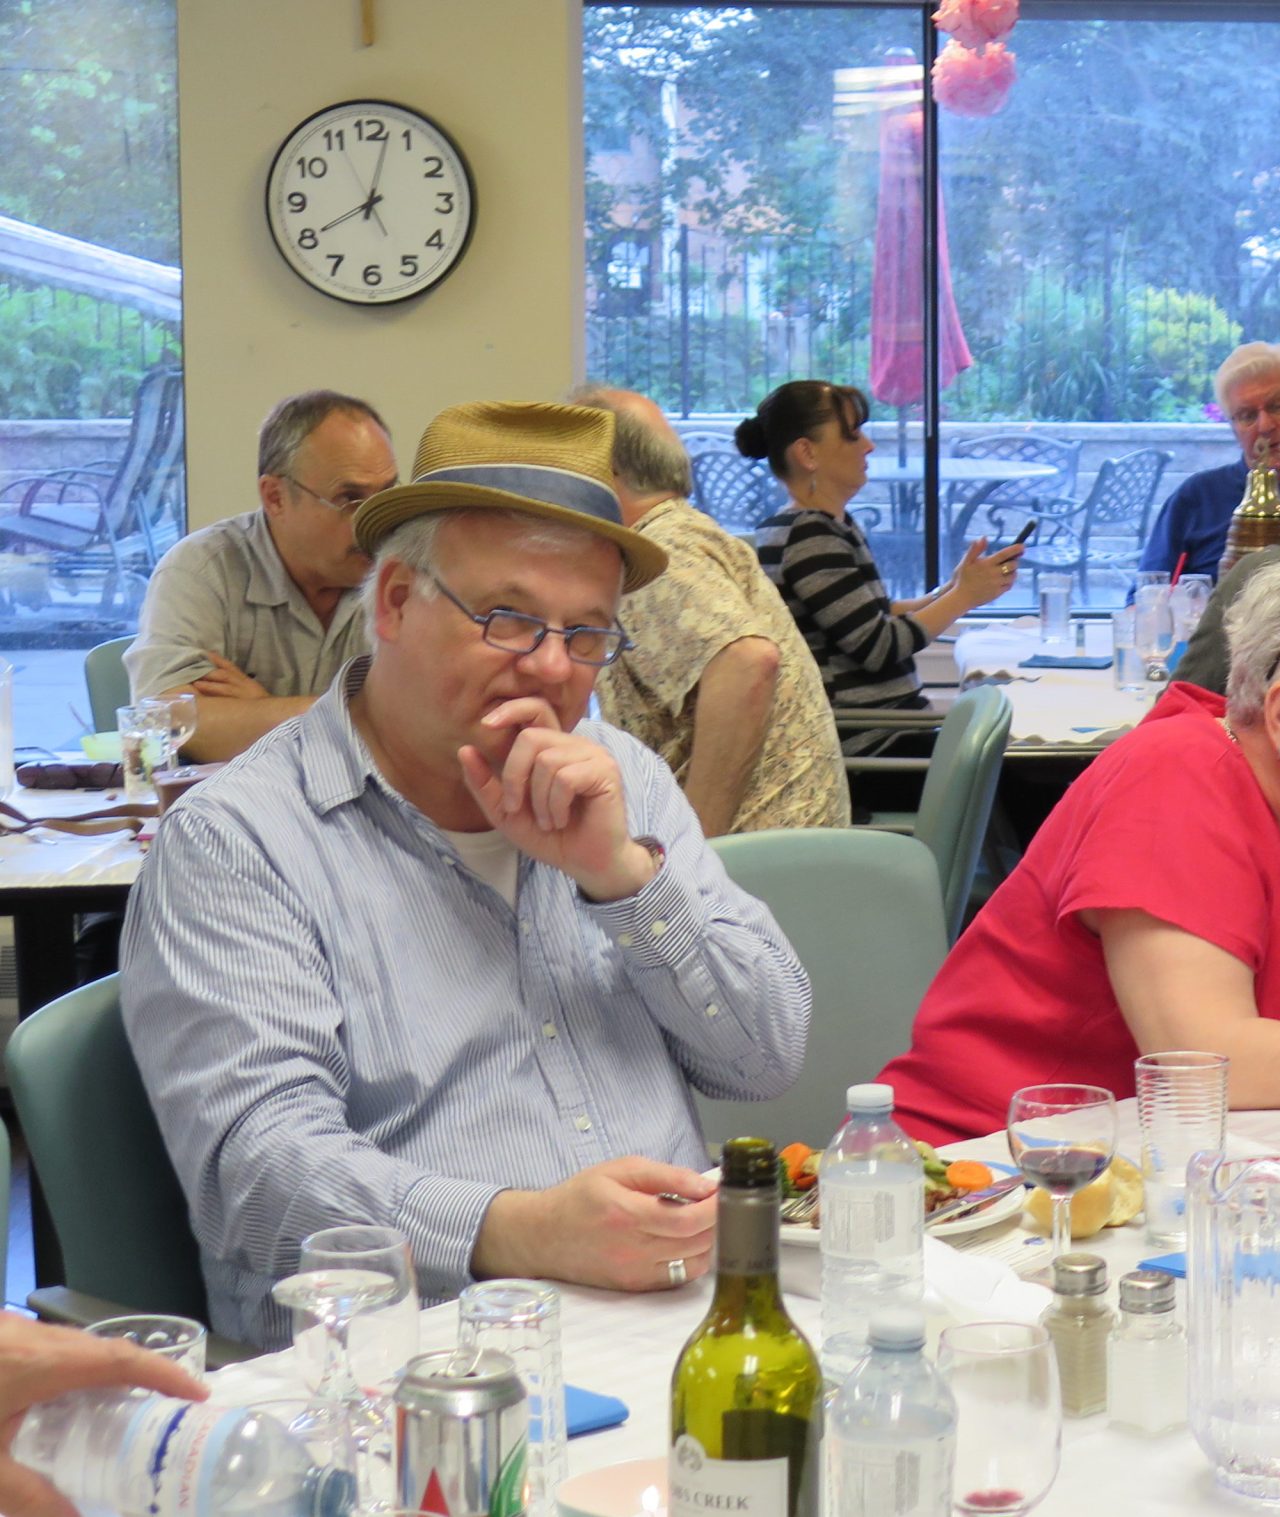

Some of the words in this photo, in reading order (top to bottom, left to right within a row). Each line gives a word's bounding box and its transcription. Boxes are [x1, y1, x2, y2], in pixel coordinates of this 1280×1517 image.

[323, 129, 345, 151] 11
[353, 119, 386, 141] 12
[402, 129, 412, 151] 1
[297, 157, 328, 179] 10
[423, 156, 444, 178] 2
[287, 191, 307, 213] 9
[434, 192, 454, 214] 3
[297, 228, 319, 250] 8
[425, 228, 445, 251] 4
[326, 254, 345, 277] 7
[362, 264, 383, 287] 6
[399, 254, 419, 277] 5
[693, 1491, 749, 1510] CREEK
